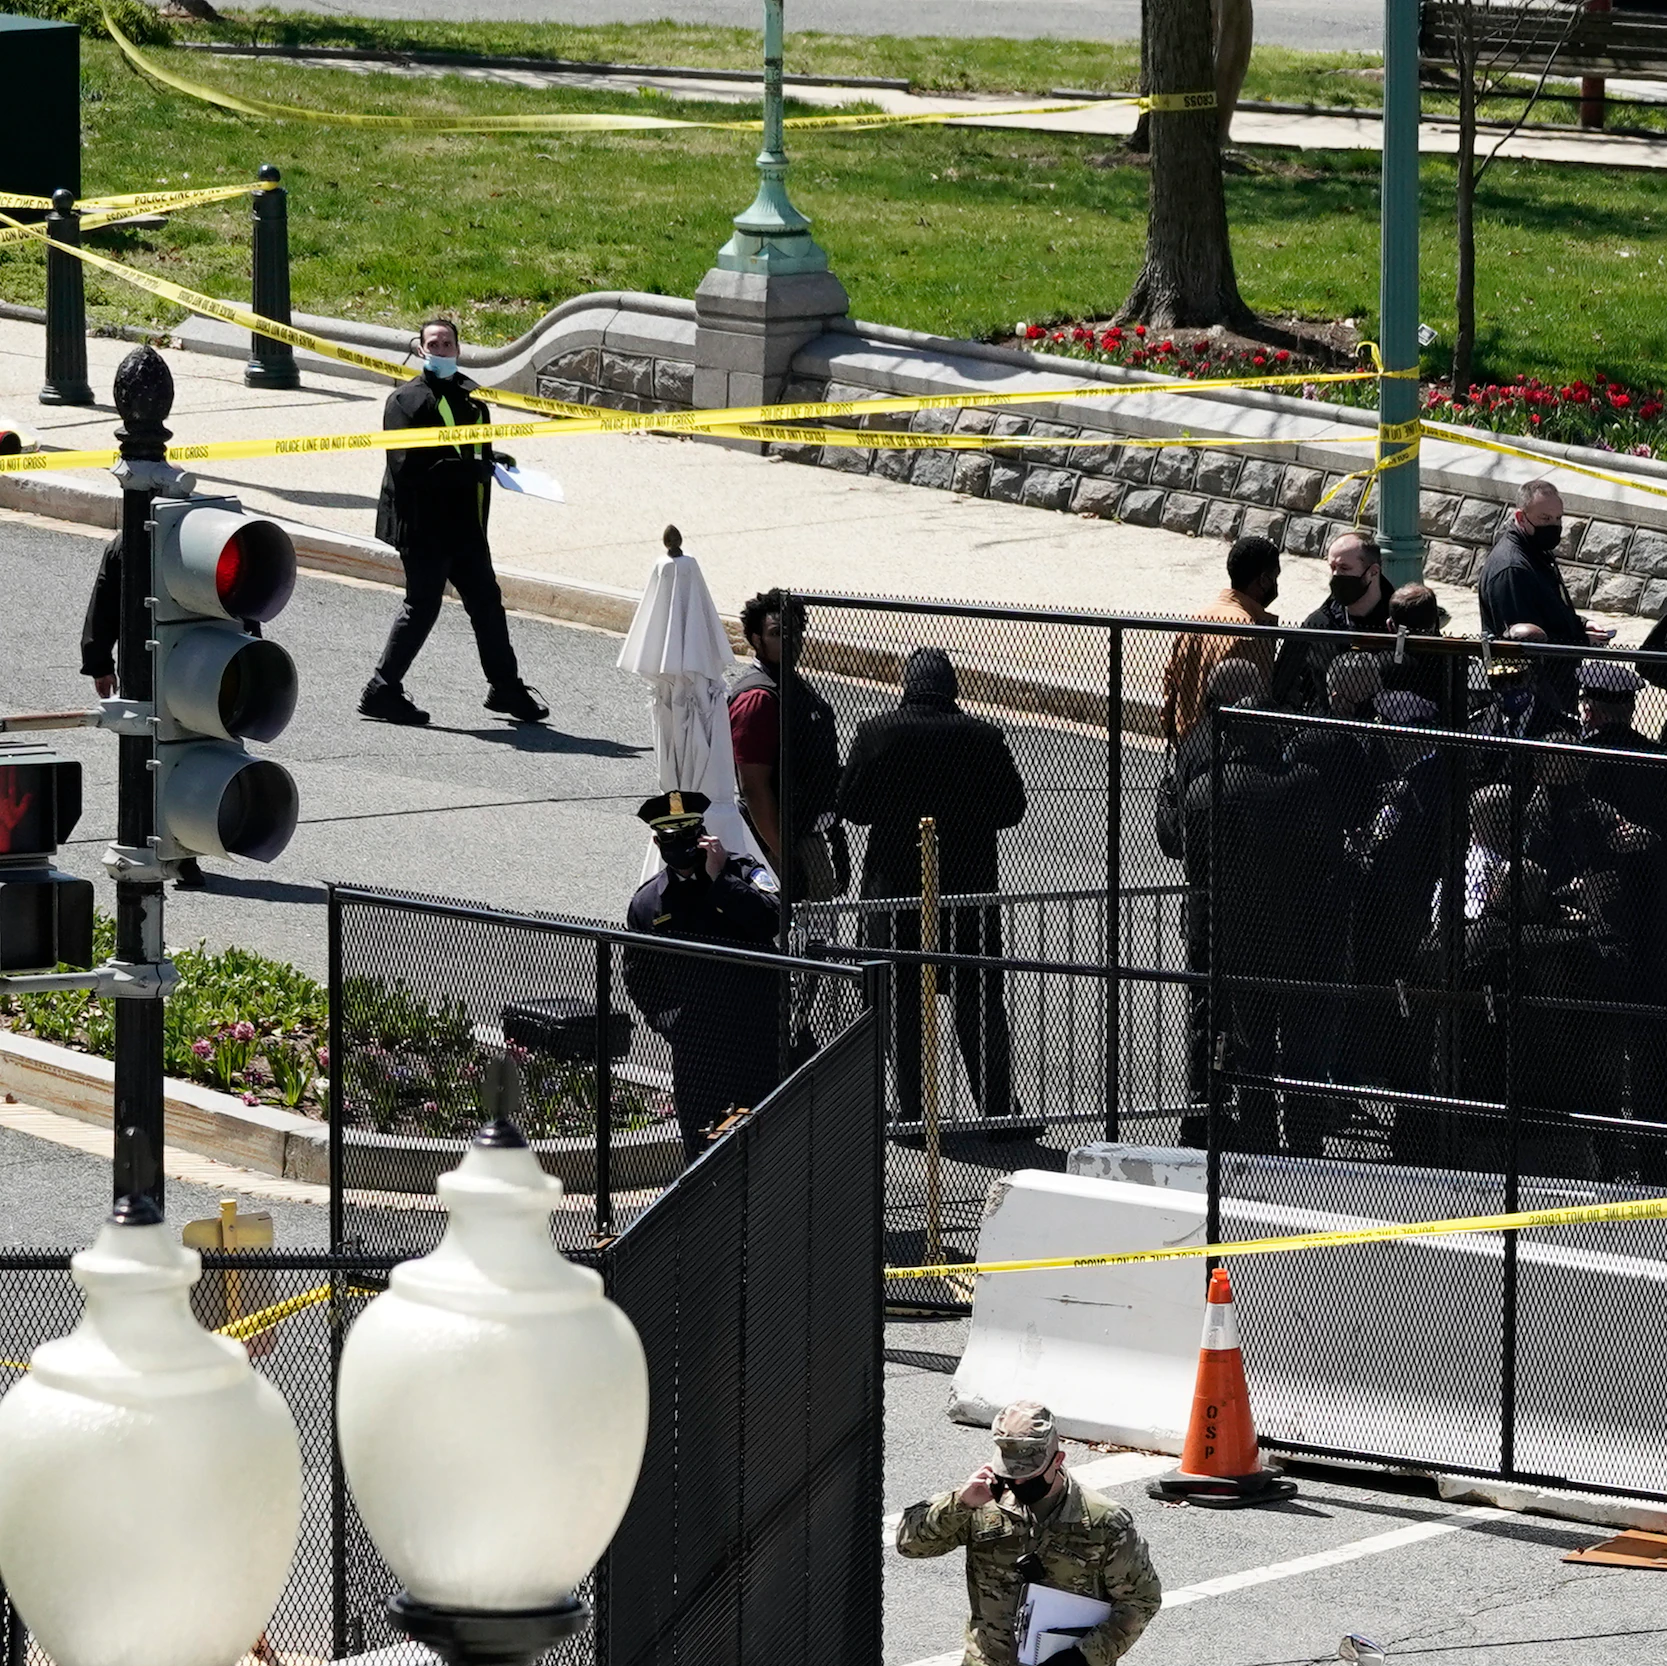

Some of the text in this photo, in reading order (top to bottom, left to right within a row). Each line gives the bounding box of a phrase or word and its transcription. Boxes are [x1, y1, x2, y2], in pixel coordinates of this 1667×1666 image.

[600, 412, 696, 431] POLICE LINE DO NOT CROSS
[438, 424, 535, 443] POLICE LINE DO NOT CROSS
[169, 446, 209, 460] NOT CROSS
[275, 434, 372, 453] POLICE LINE DO NOT CROSS
[7, 456, 47, 471] NOT CROSS
